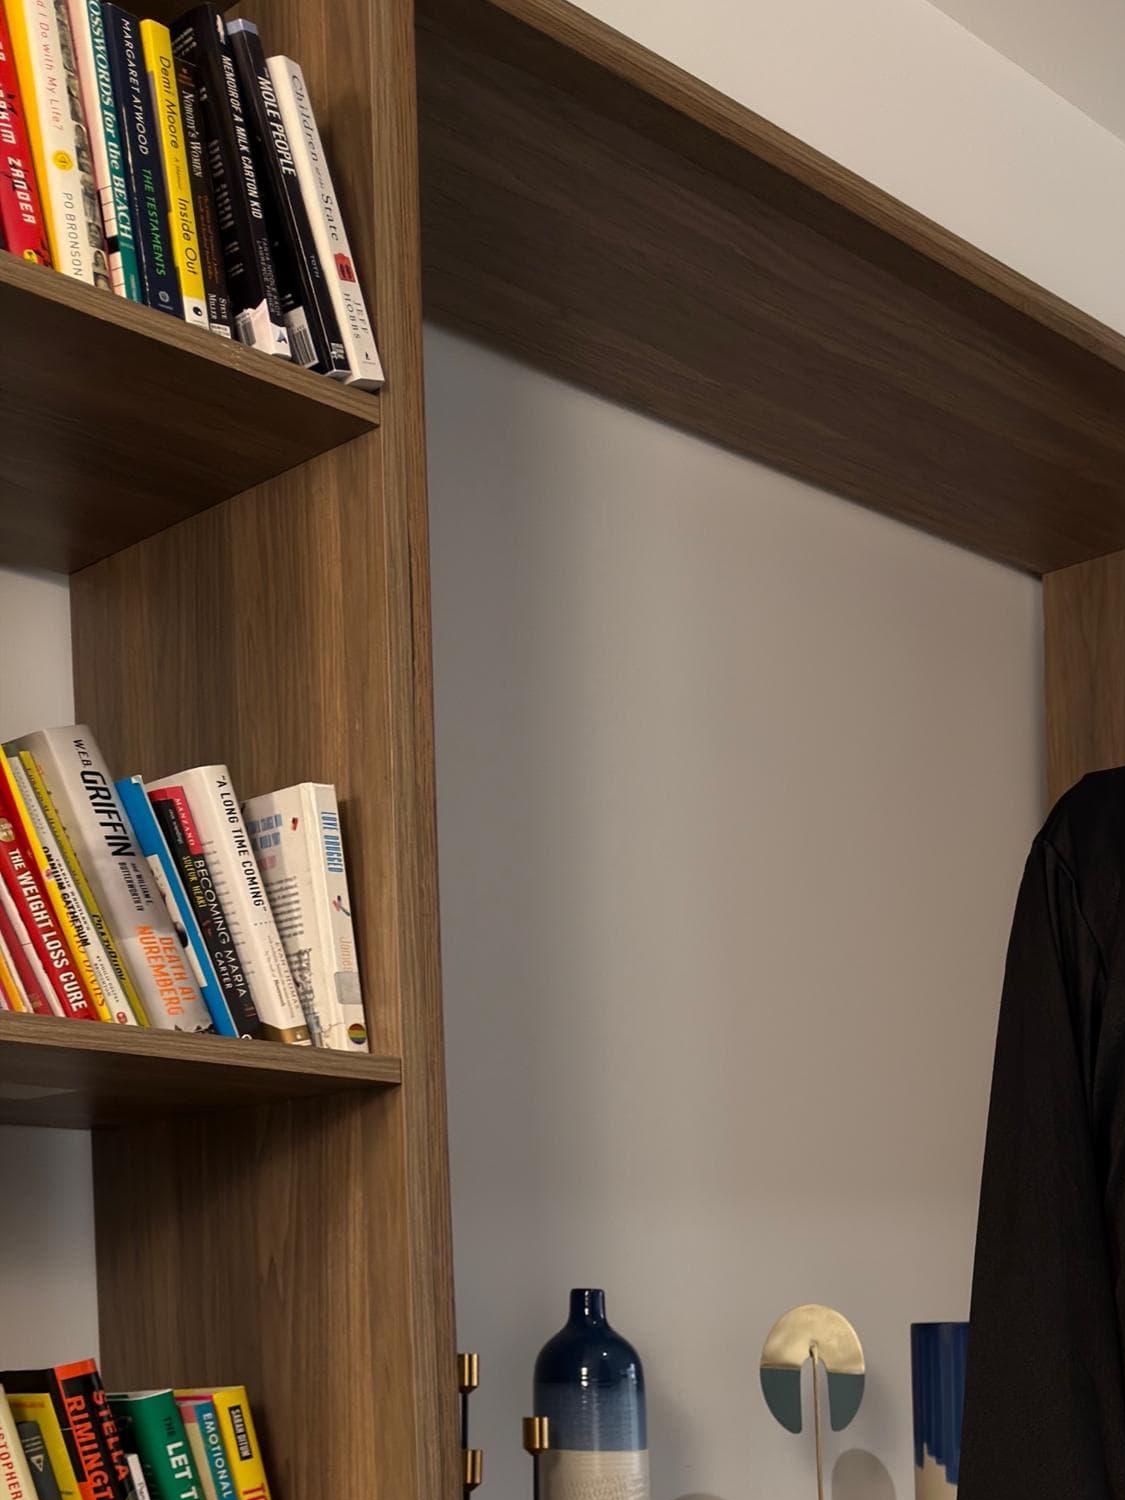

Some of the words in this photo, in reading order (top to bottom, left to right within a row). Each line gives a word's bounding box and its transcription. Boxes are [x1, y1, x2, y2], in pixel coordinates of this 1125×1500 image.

[40, 22, 49, 38] Do
[42, 43, 54, 71] with
[88, 0, 115, 107] OSSWORDS
[46, 76, 58, 94] My
[121, 18, 140, 93] MARGARET
[132, 95, 149, 155] ATWOOD
[222, 55, 239, 98] MEMOIR
[49, 99, 64, 131] Life?
[159, 55, 173, 96] Demi
[166, 100, 180, 149] Moore
[230, 98, 242, 114] OF
[232, 114, 244, 123] A
[104, 111, 117, 138] for
[235, 125, 249, 153] MILK
[257, 76, 280, 122] MOLE
[270, 122, 297, 177] PEOPLE
[108, 141, 122, 170] the
[241, 155, 259, 198] CARTON
[292, 75, 319, 162] Children
[321, 193, 339, 241] State
[7, 156, 36, 225] ZANDER
[63, 192, 74, 209] PO
[142, 168, 155, 192] THE
[112, 175, 133, 240] BEACH
[177, 198, 195, 241] Inside
[250, 199, 263, 220] KID
[65, 213, 84, 276] BRONSON
[148, 196, 166, 276] TESTAMENTS
[184, 248, 200, 275] Out
[344, 293, 361, 339] HOBBS
[354, 301, 369, 334] JEFF
[80, 771, 136, 856] GRIFFIN
[175, 798, 196, 846] MANZANO
[220, 792, 239, 824] LONG
[232, 828, 250, 857] TIME
[9, 848, 26, 870] THE
[17, 870, 54, 929] WEIGHT
[61, 892, 91, 947] GATHERUM
[42, 931, 70, 969] LOSS
[193, 860, 231, 945] BECOMING
[223, 950, 247, 997] MARIA
[137, 925, 184, 1017] NUREMBERG
[159, 937, 189, 982] DEATH
[178, 985, 197, 1001] AT
[215, 952, 233, 989] CARTER
[59, 971, 88, 1012] CURE
[92, 1391, 129, 1482] STELLA
[163, 1417, 176, 1436] THE
[231, 1408, 244, 1433] SARAH
[166, 1441, 193, 1479] LET
[203, 1412, 233, 1498] EMOTIONAL
